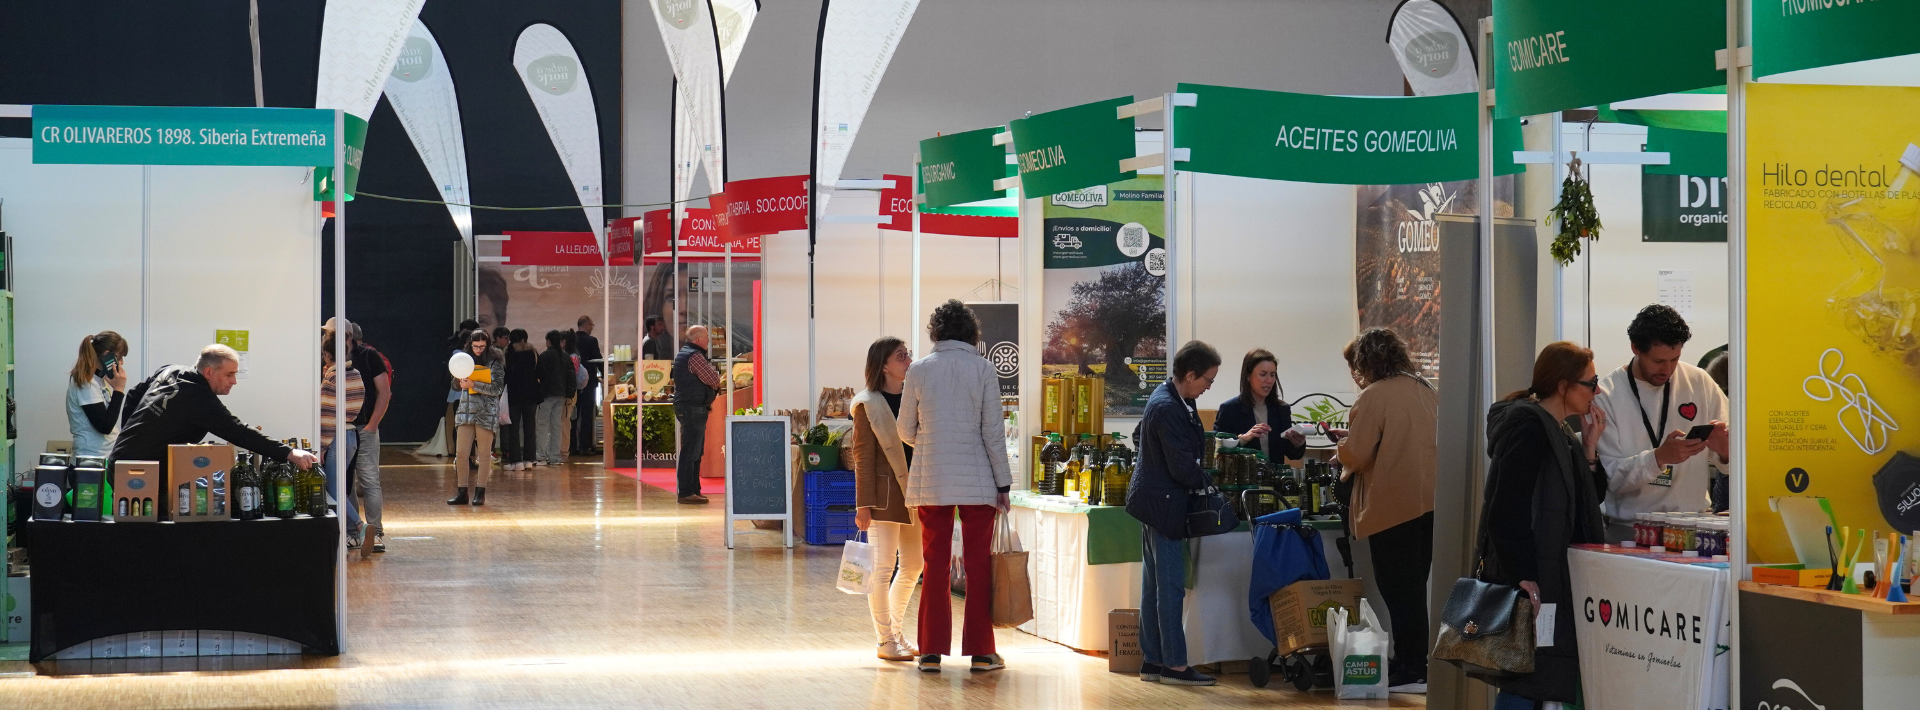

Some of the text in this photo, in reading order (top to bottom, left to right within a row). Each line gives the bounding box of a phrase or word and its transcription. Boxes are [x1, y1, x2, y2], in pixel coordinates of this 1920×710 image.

[1508, 30, 1570, 72] GOMICARE
[41, 126, 326, 147] CR OLIVAREROS 1898. Siberia Extremeña
[1275, 124, 1458, 153] ACEITES GOMEOLIVA
[1763, 162, 1890, 188] Hilo dental
[1763, 188, 1816, 198] FABRICADO
[1818, 189, 1840, 198] CON
[1842, 190, 1885, 199] BOTELLAS
[1888, 190, 1900, 199] DE
[1763, 200, 1818, 209] RECICLADO.
[1398, 220, 1440, 253] GOMEO
[555, 244, 565, 254] LA
[1791, 473, 1803, 488] V
[1345, 667, 1378, 675] ASTUR
